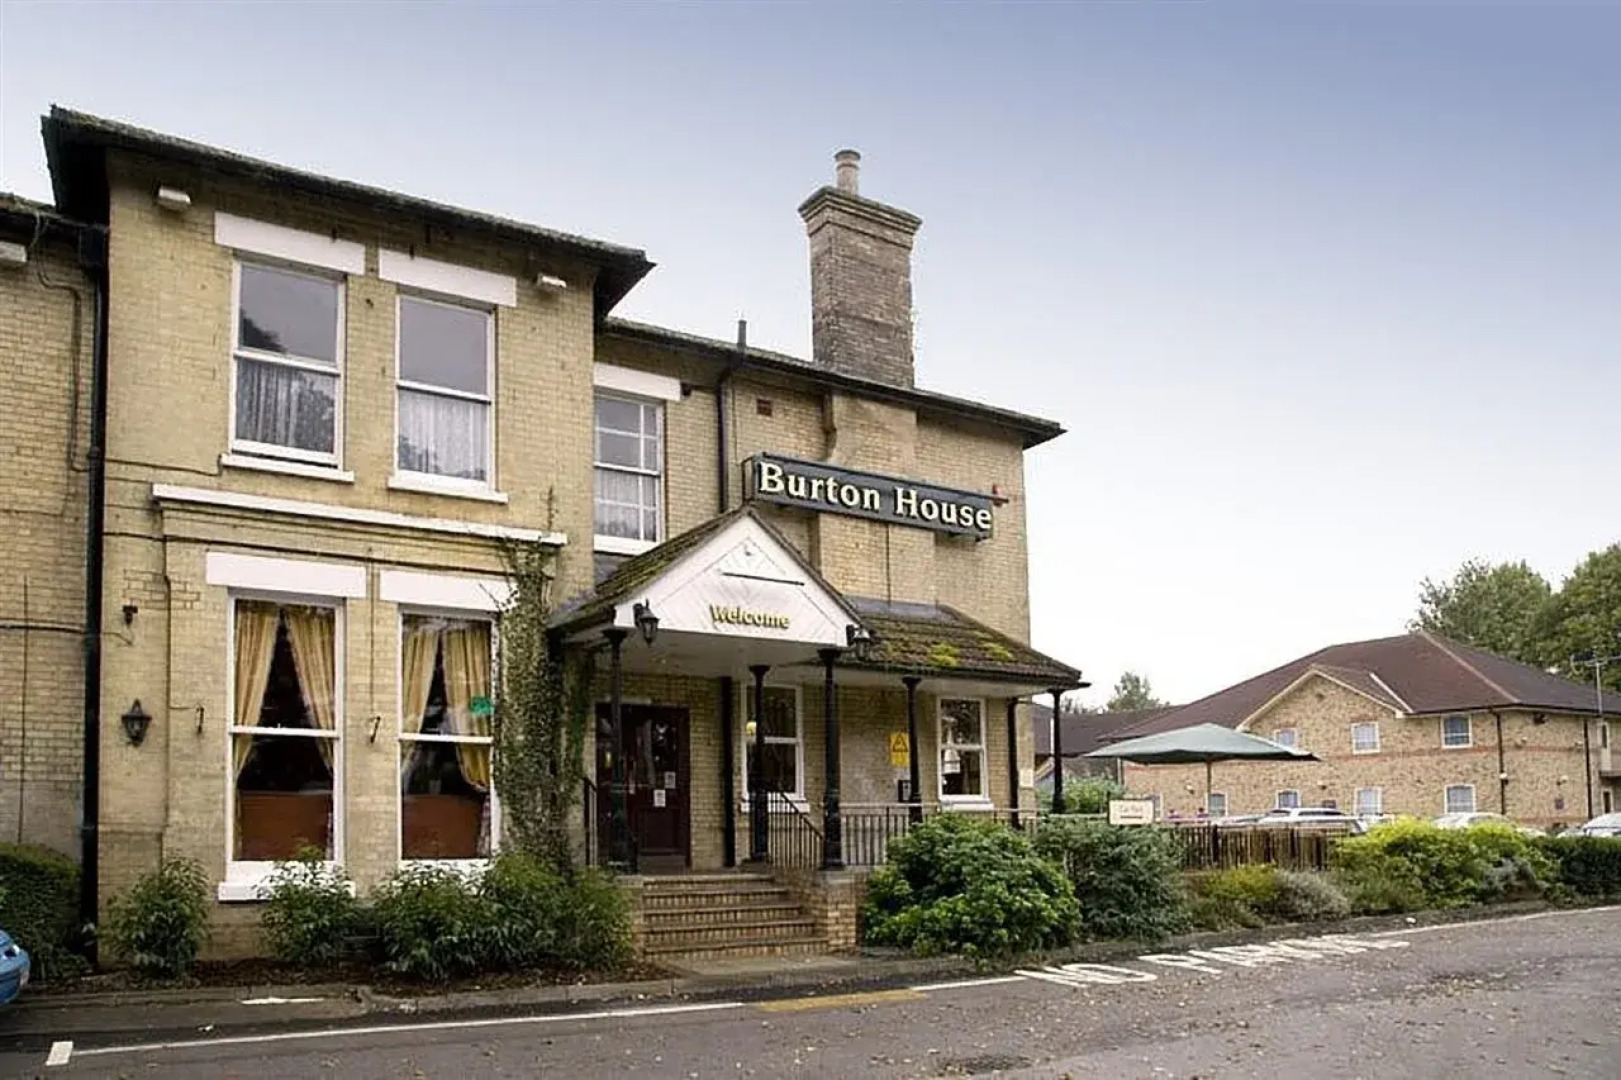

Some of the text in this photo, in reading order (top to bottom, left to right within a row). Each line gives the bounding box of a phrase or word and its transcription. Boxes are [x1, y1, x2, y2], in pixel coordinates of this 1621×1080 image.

[759, 461, 993, 530] Burton House
[709, 604, 789, 629] Welcome
[1013, 963, 1158, 988] NO
